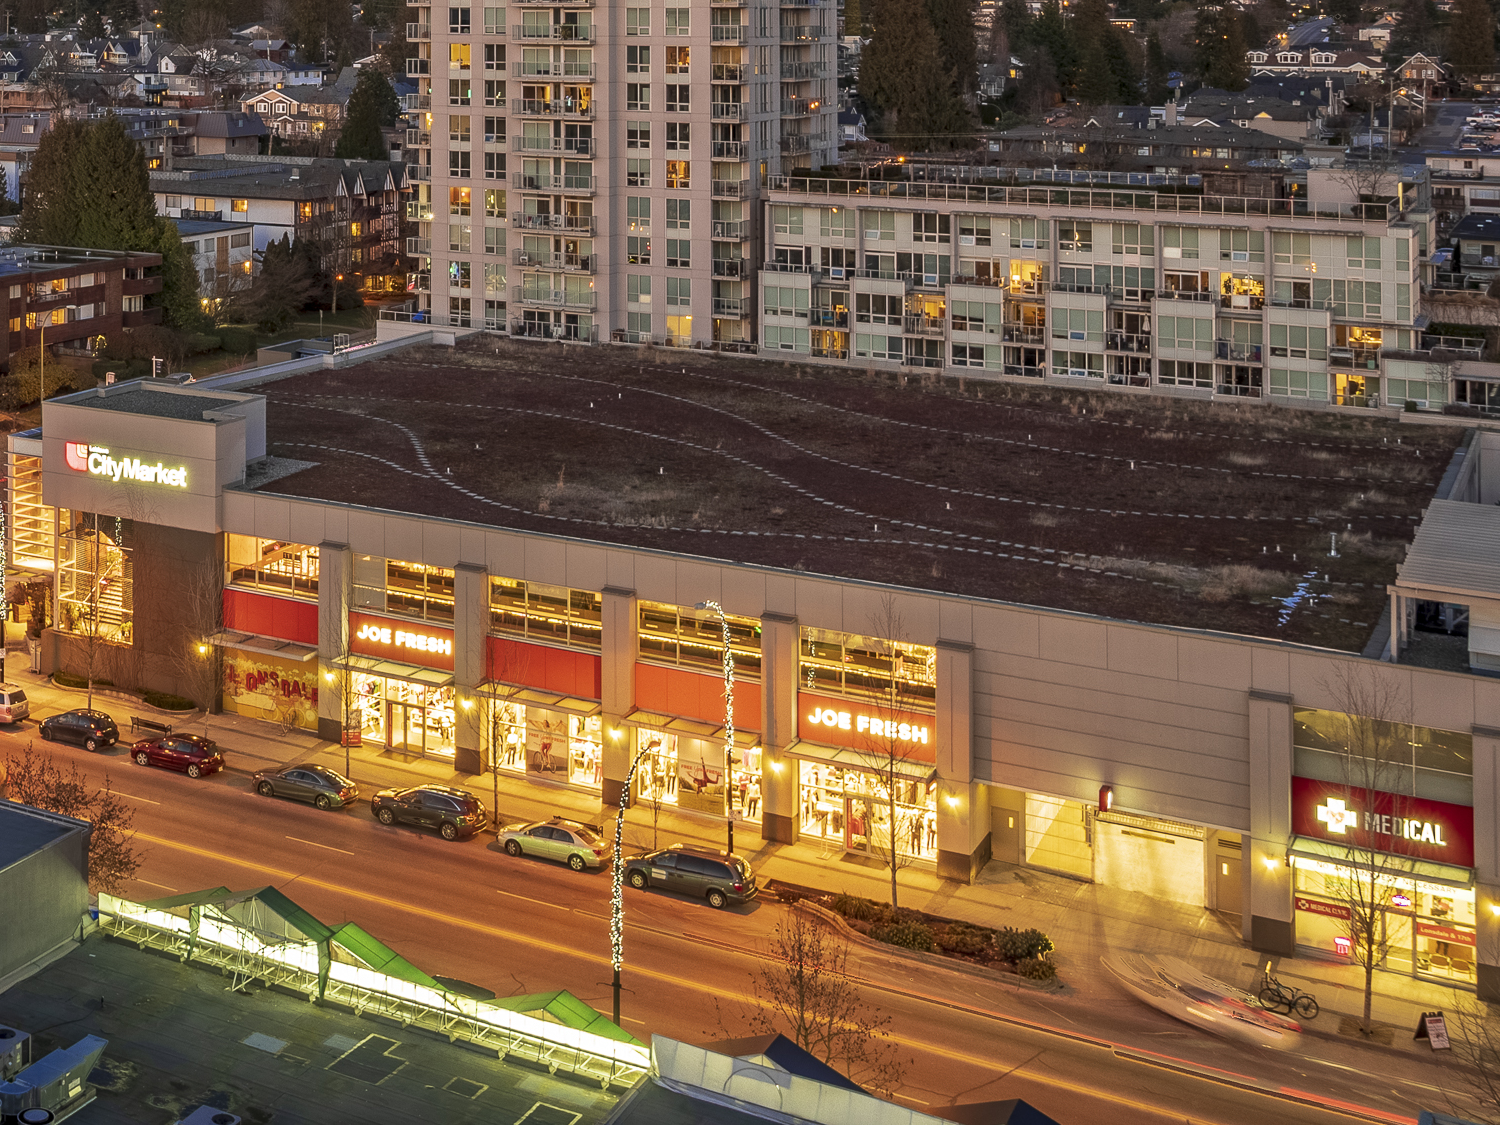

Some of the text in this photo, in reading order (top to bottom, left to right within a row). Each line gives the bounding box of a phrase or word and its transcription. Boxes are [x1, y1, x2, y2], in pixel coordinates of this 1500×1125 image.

[357, 624, 452, 655] JOE FRESH
[228, 664, 319, 708] LONSDALE
[807, 707, 929, 745] JOE FRESH
[1364, 811, 1448, 847] MEDICAL
[1316, 861, 1329, 870] NO
[1311, 903, 1332, 914] MEDICAL
[1420, 926, 1449, 938] Lonsdale
[1457, 934, 1472, 943] 17th
